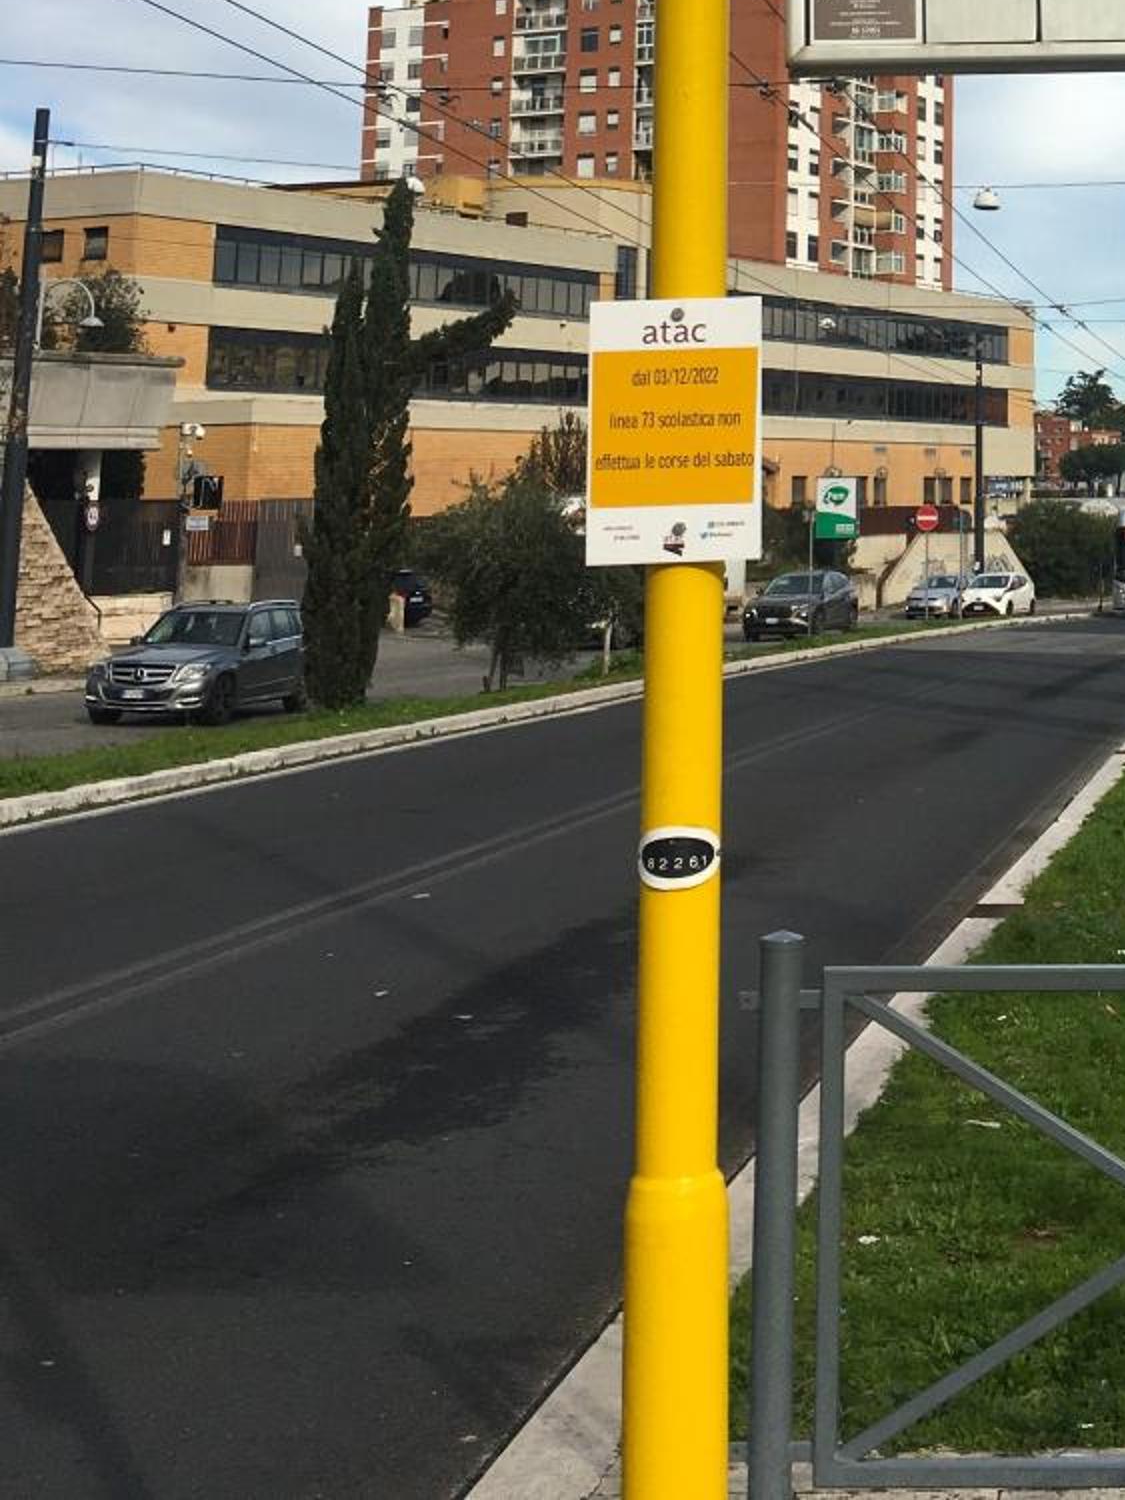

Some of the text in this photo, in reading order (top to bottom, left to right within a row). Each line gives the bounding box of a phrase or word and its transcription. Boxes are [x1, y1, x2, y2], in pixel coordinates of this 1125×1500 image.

[643, 322, 706, 344] atac
[632, 367, 718, 385] dal 03/12/2022
[609, 412, 740, 428] linea 73 scolastica non
[595, 451, 754, 470] effettua le corse del sabato
[648, 855, 707, 870] 82261
